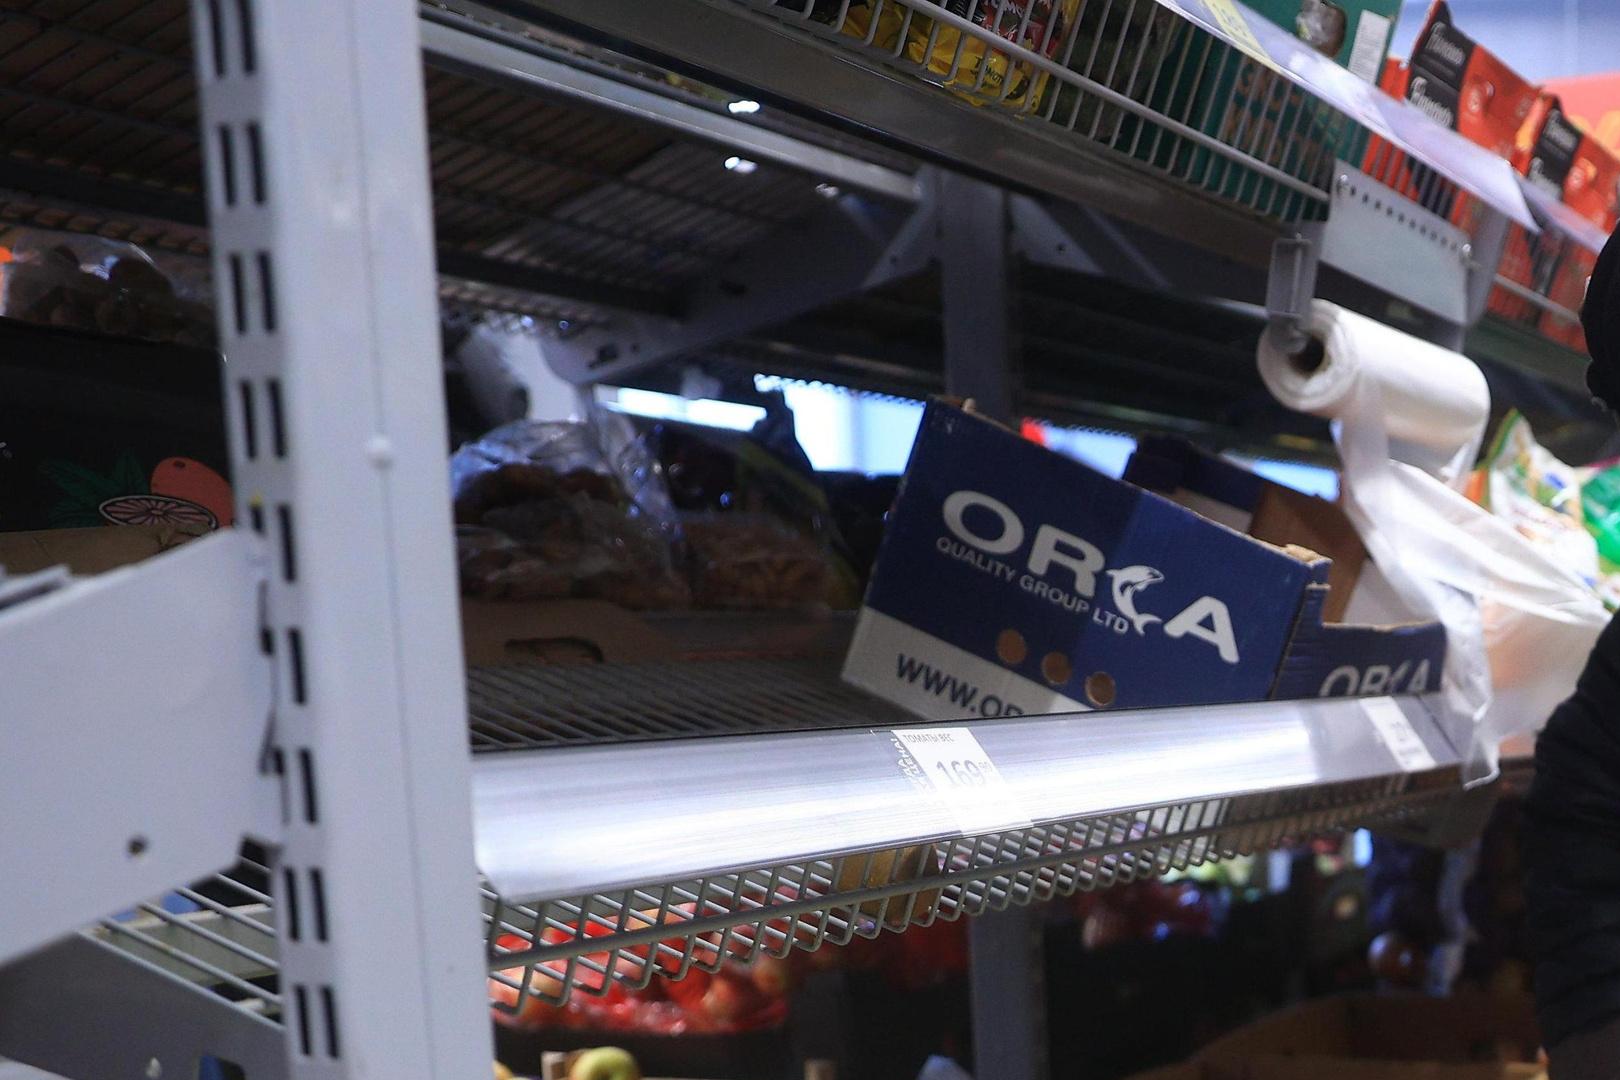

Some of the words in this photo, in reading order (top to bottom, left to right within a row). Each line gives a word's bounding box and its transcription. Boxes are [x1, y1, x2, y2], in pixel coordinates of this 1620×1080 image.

[935, 537, 1016, 583] QUALITY
[1019, 574, 1090, 614] GROUP
[1092, 607, 1129, 635] LTD
